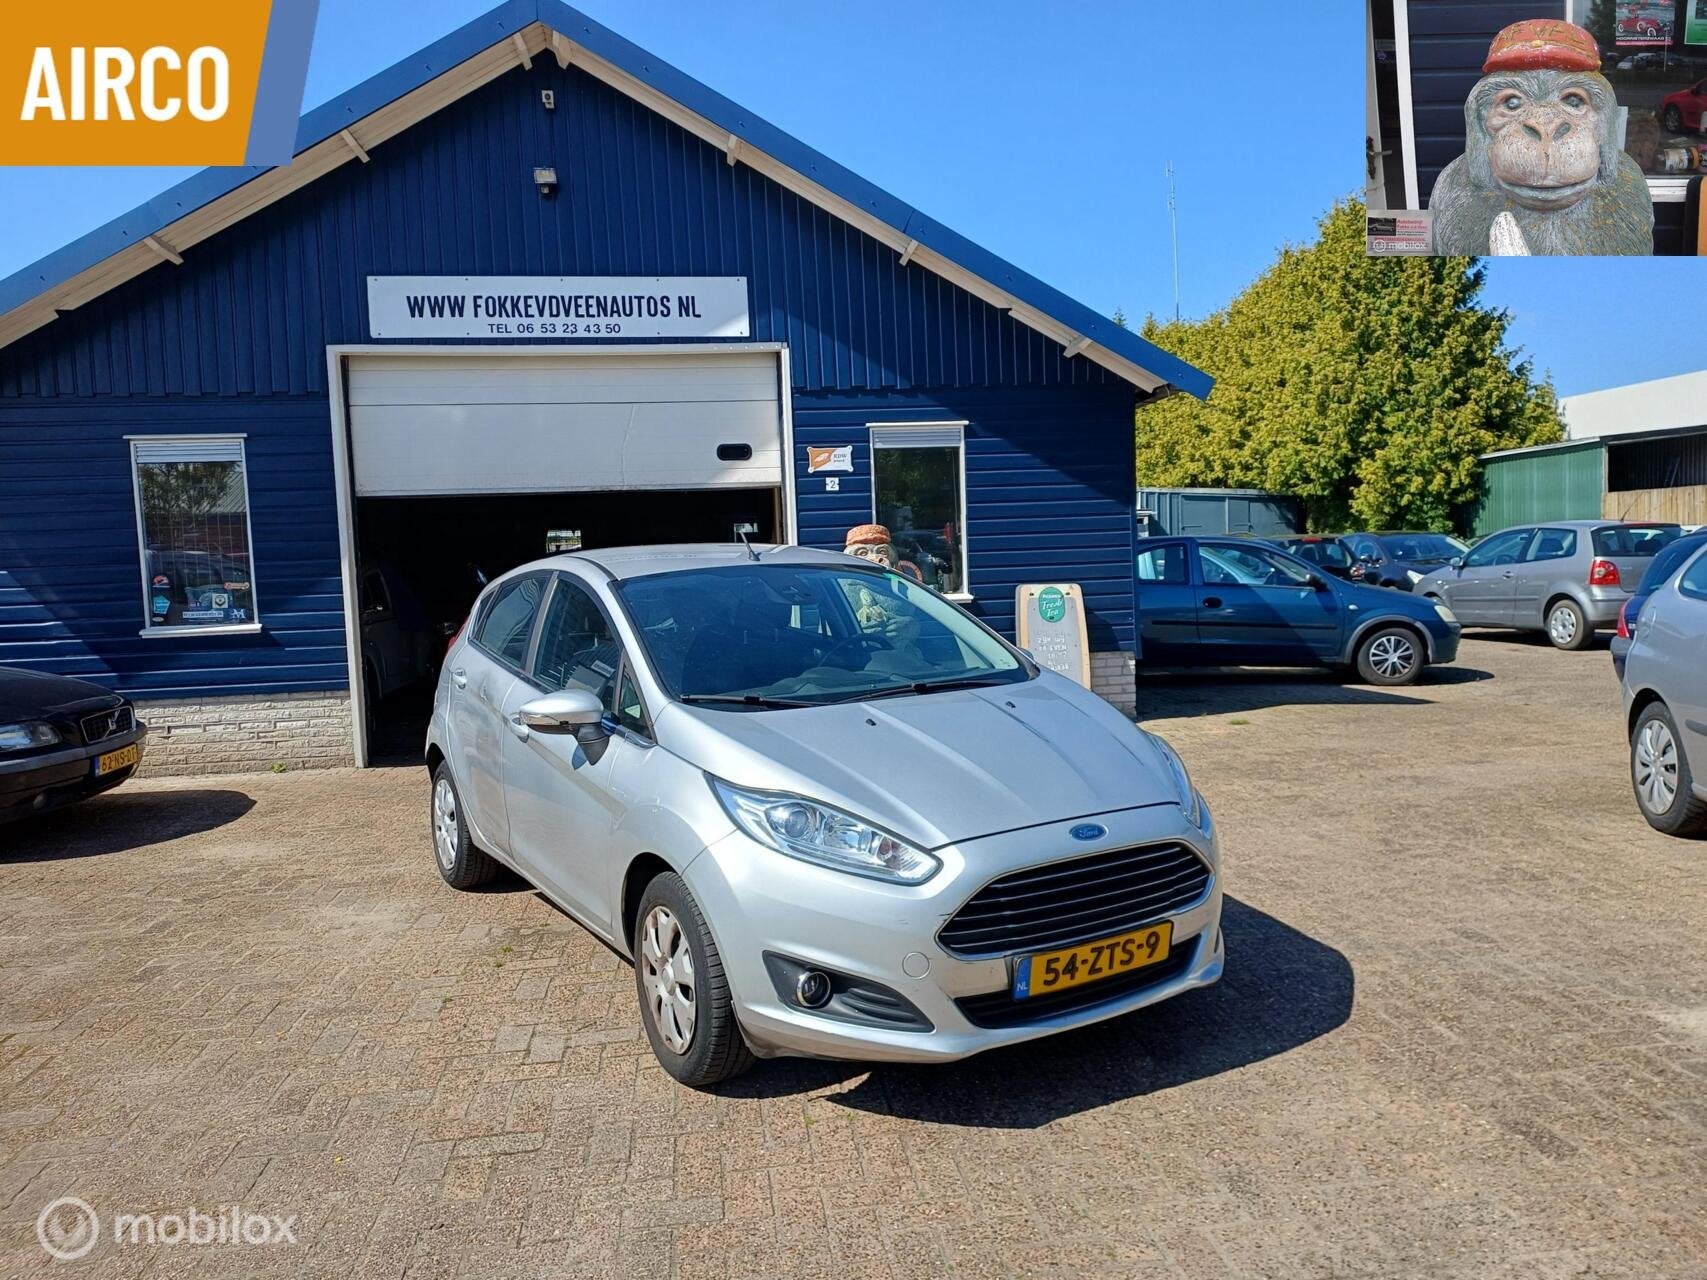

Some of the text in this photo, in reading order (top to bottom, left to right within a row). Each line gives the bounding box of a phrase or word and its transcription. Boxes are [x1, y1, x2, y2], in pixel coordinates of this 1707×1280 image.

[406, 295, 702, 318] WWW FOKKEVDVEENAUTOS NL
[488, 323, 621, 334] TEL 06 53 23 43 50
[830, 480, 836, 489] 2
[1043, 931, 1161, 987] 54-ZTS-9
[1017, 981, 1029, 992] NL
